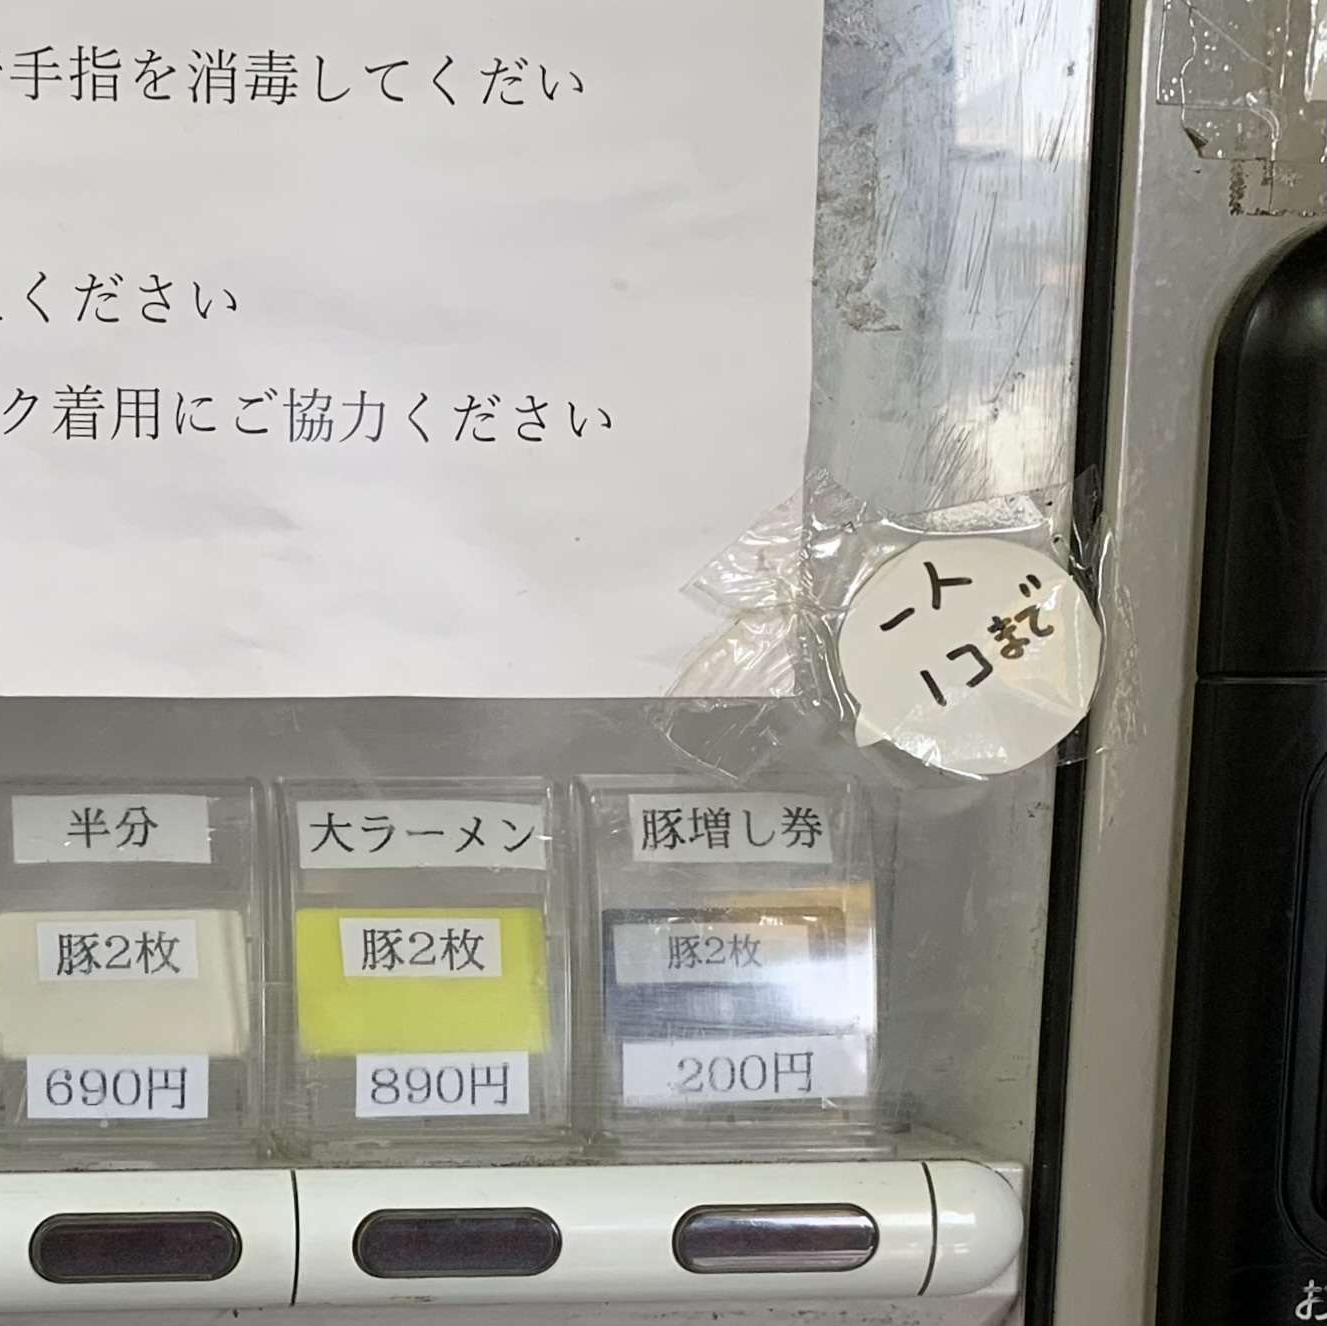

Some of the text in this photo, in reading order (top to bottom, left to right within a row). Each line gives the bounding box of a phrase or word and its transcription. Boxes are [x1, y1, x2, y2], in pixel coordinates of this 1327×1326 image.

[67, 806, 158, 849] 半分
[310, 812, 534, 852] 大ラーメン
[642, 807, 822, 850] 豚増し券
[57, 931, 180, 976] 豚2枚
[362, 928, 485, 971] 豚2枚
[668, 934, 761, 969] 豚2枚
[46, 1067, 187, 1110] 690円
[371, 1063, 508, 1105] 890円
[678, 1052, 813, 1093] 200円
